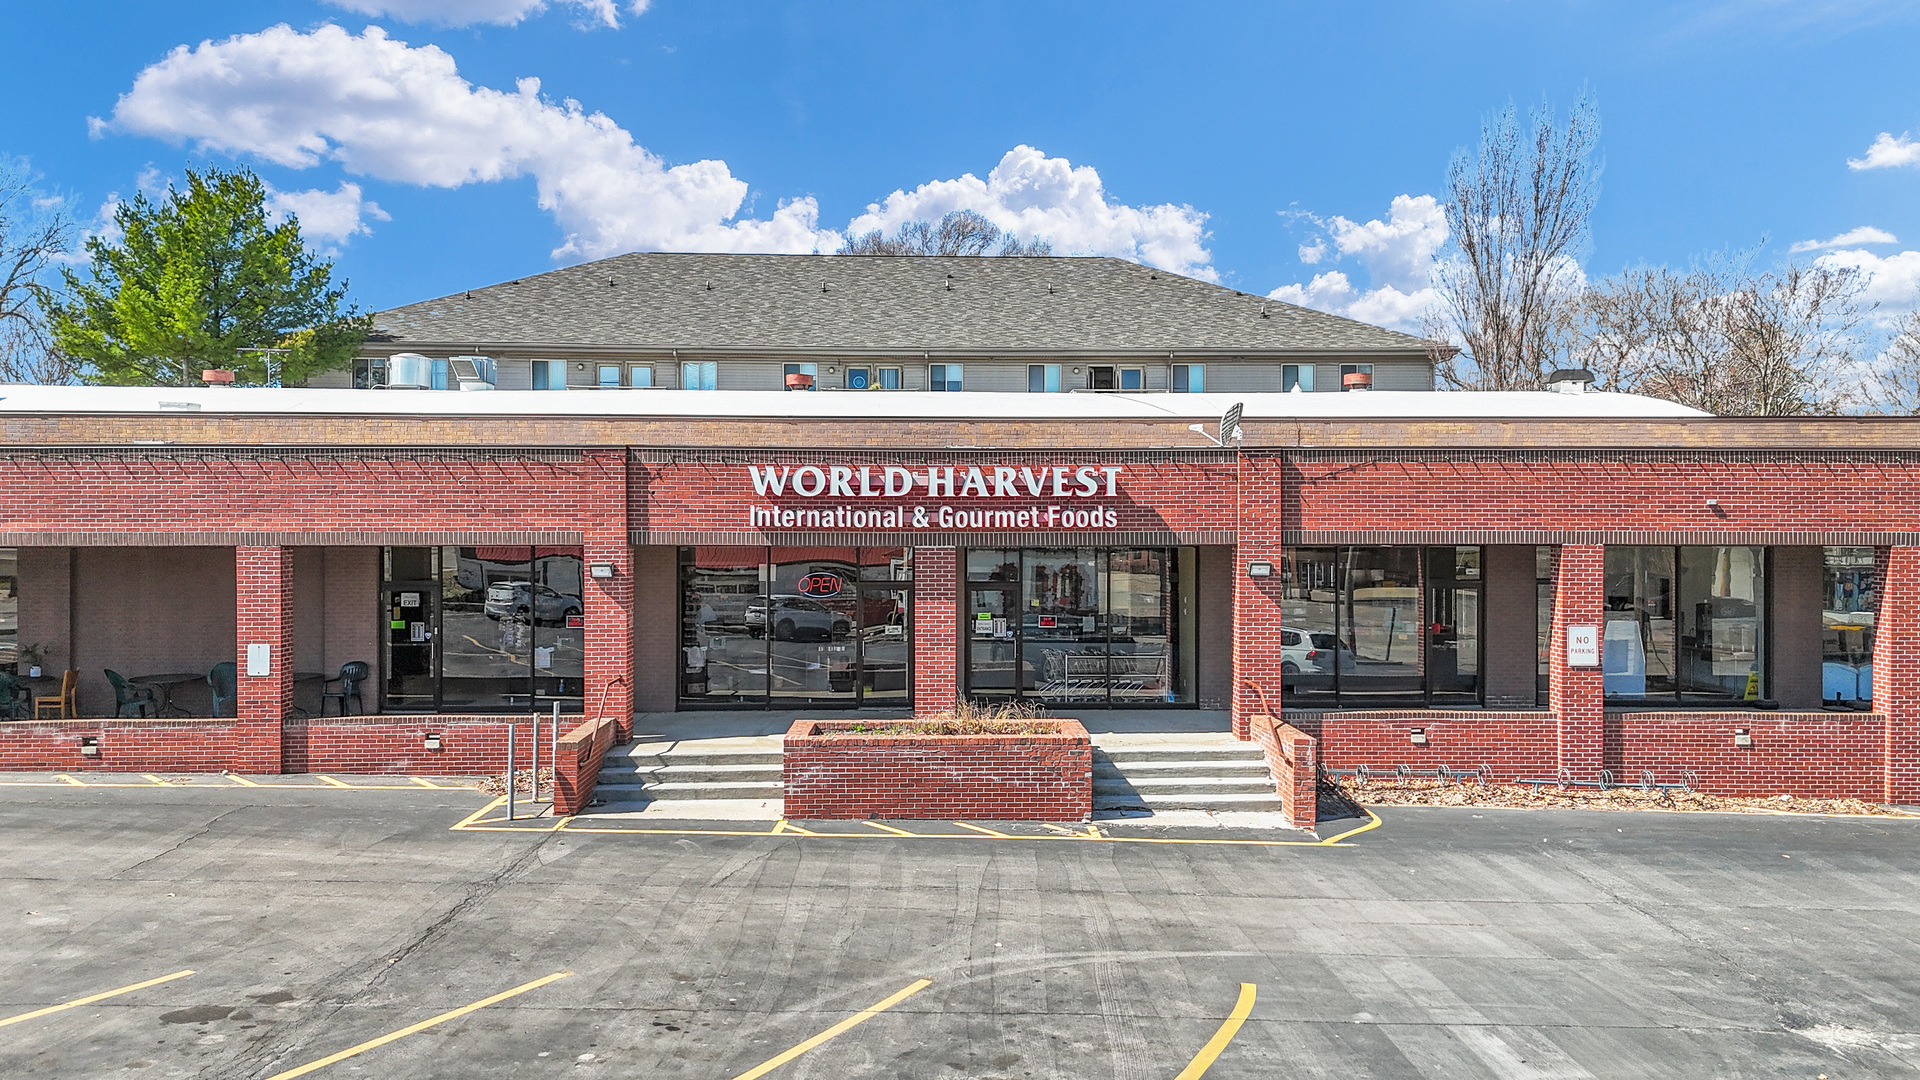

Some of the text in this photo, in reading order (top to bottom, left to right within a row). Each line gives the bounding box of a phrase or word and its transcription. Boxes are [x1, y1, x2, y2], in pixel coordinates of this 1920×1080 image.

[748, 466, 1122, 497] WORLD HARVEST
[750, 505, 1118, 528] International & Gourmet Foods
[798, 577, 842, 593] OPEN
[1576, 636, 1590, 644] NO
